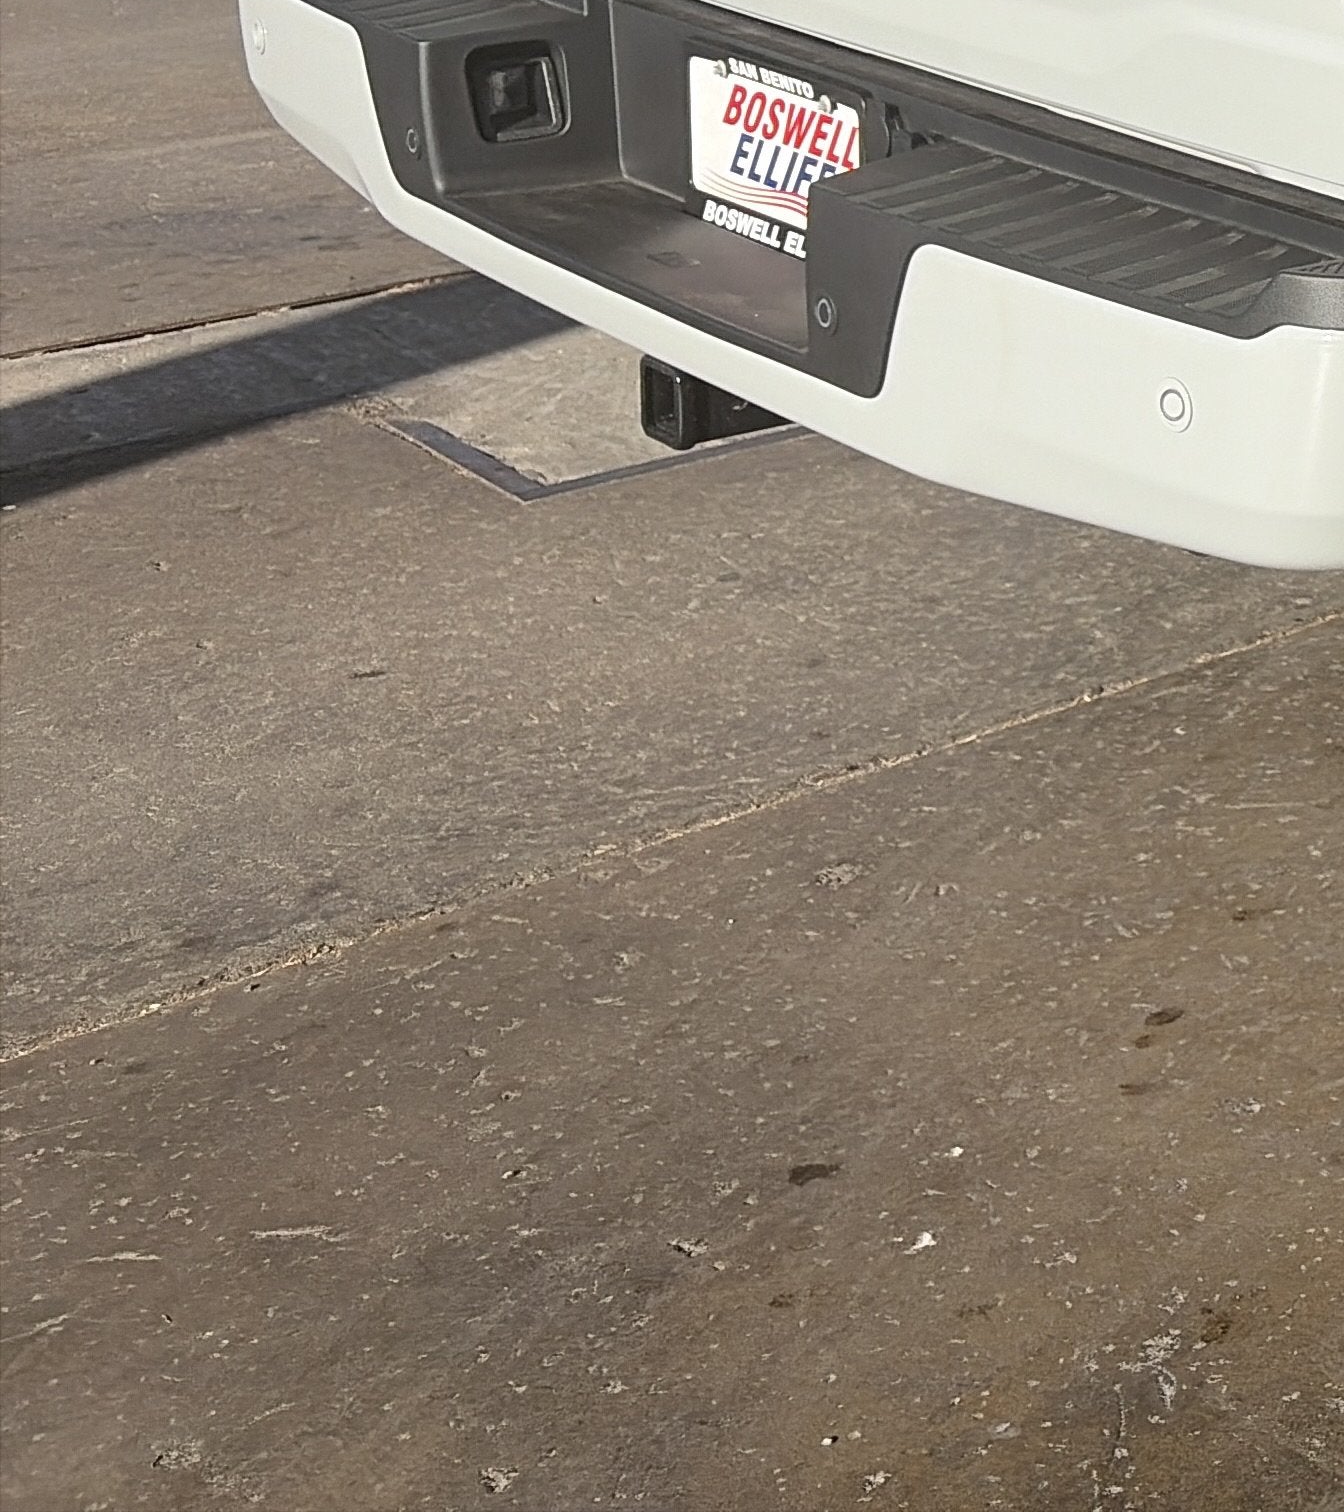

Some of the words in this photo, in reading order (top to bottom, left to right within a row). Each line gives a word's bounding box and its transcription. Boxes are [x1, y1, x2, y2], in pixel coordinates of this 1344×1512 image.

[728, 57, 759, 82] SAN
[759, 67, 815, 99] BENITO
[722, 84, 860, 169] BOSWELL
[703, 199, 781, 249] BOSWELL
